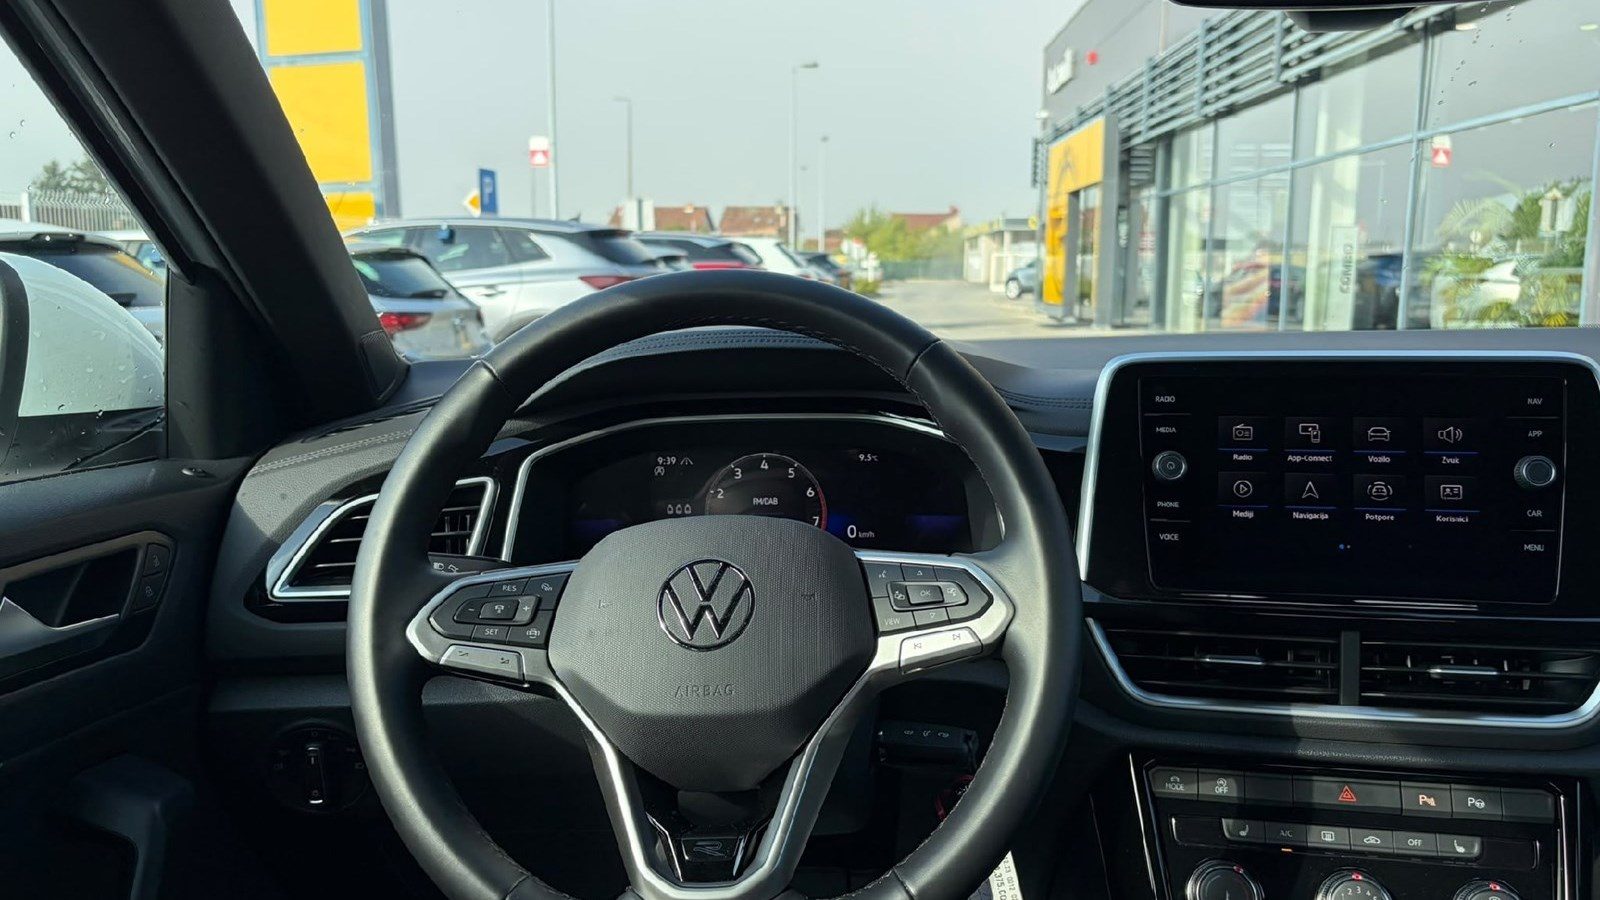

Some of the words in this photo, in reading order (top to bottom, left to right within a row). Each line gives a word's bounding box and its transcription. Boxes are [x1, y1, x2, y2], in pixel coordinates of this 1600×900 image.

[1155, 395, 1176, 403] RADIO
[657, 456, 677, 465] 9:39
[1287, 454, 1333, 462] App-Connect
[1367, 455, 1391, 463] Vozilo
[1441, 456, 1460, 464] Zvuk
[760, 460, 769, 470] 4
[734, 468, 742, 480] 3
[787, 468, 795, 479] 5
[717, 489, 724, 499] 2
[806, 487, 815, 497] 6
[752, 497, 779, 506] FM/DAB
[1292, 511, 1329, 520] Navigacija
[1365, 513, 1395, 521] Potpore
[812, 516, 820, 527] 7
[846, 525, 857, 539] 0
[858, 531, 875, 539] km/h
[1159, 533, 1180, 541] VOICE
[1523, 544, 1545, 552] MENU
[885, 618, 900, 626] VIEW
[484, 628, 499, 636] SET
[674, 683, 735, 699] AIRBAG
[1165, 782, 1185, 791] MODE
[1214, 785, 1229, 794] OFF
[1279, 829, 1293, 838] A/C
[1407, 838, 1423, 847] OFF
